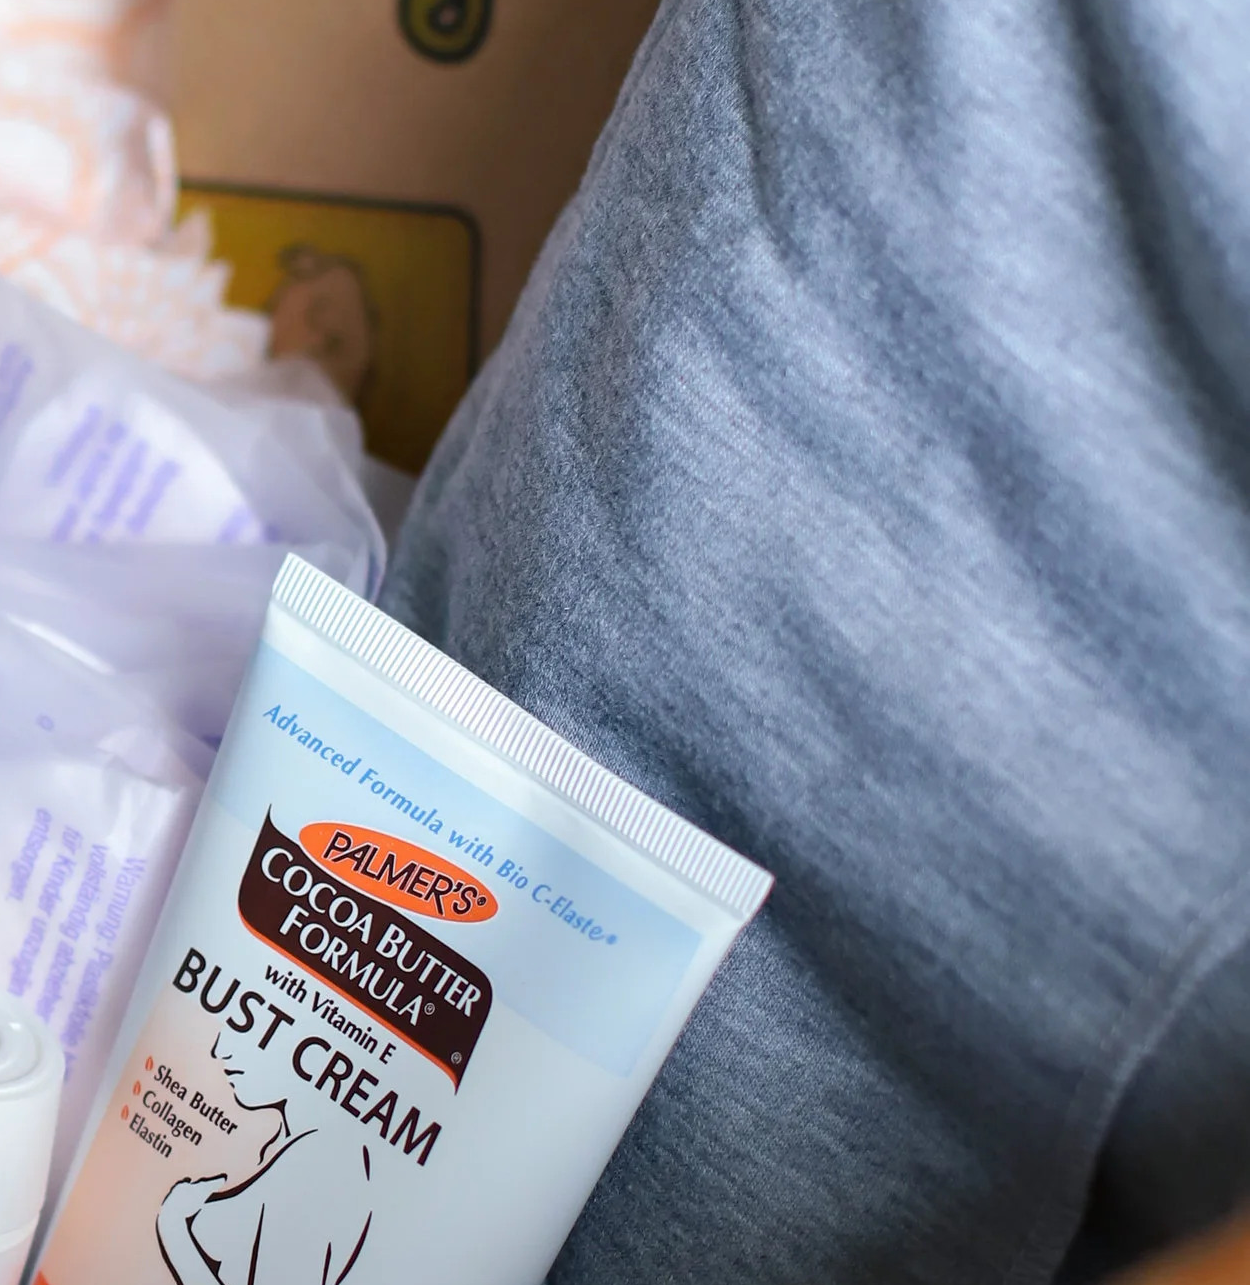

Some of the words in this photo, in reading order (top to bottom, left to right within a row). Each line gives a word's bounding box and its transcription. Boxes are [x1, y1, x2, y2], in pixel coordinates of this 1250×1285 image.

[262, 704, 362, 776] Advanced
[358, 768, 444, 835] Formula
[448, 829, 494, 867] with
[496, 858, 528, 889] Bio
[261, 847, 374, 944] COCOA
[375, 923, 482, 1018] BUTTER
[172, 947, 296, 1051] BUST
[292, 1035, 442, 1167] CREAM
[264, 965, 307, 1003] with
[311, 991, 378, 1056] Vitamin
[379, 1042, 397, 1064] E
[129, 1114, 173, 1159] Elastin
[141, 1090, 204, 1146] Collagen
[154, 1064, 187, 1101] Shea
[189, 1092, 239, 1136] Butter
